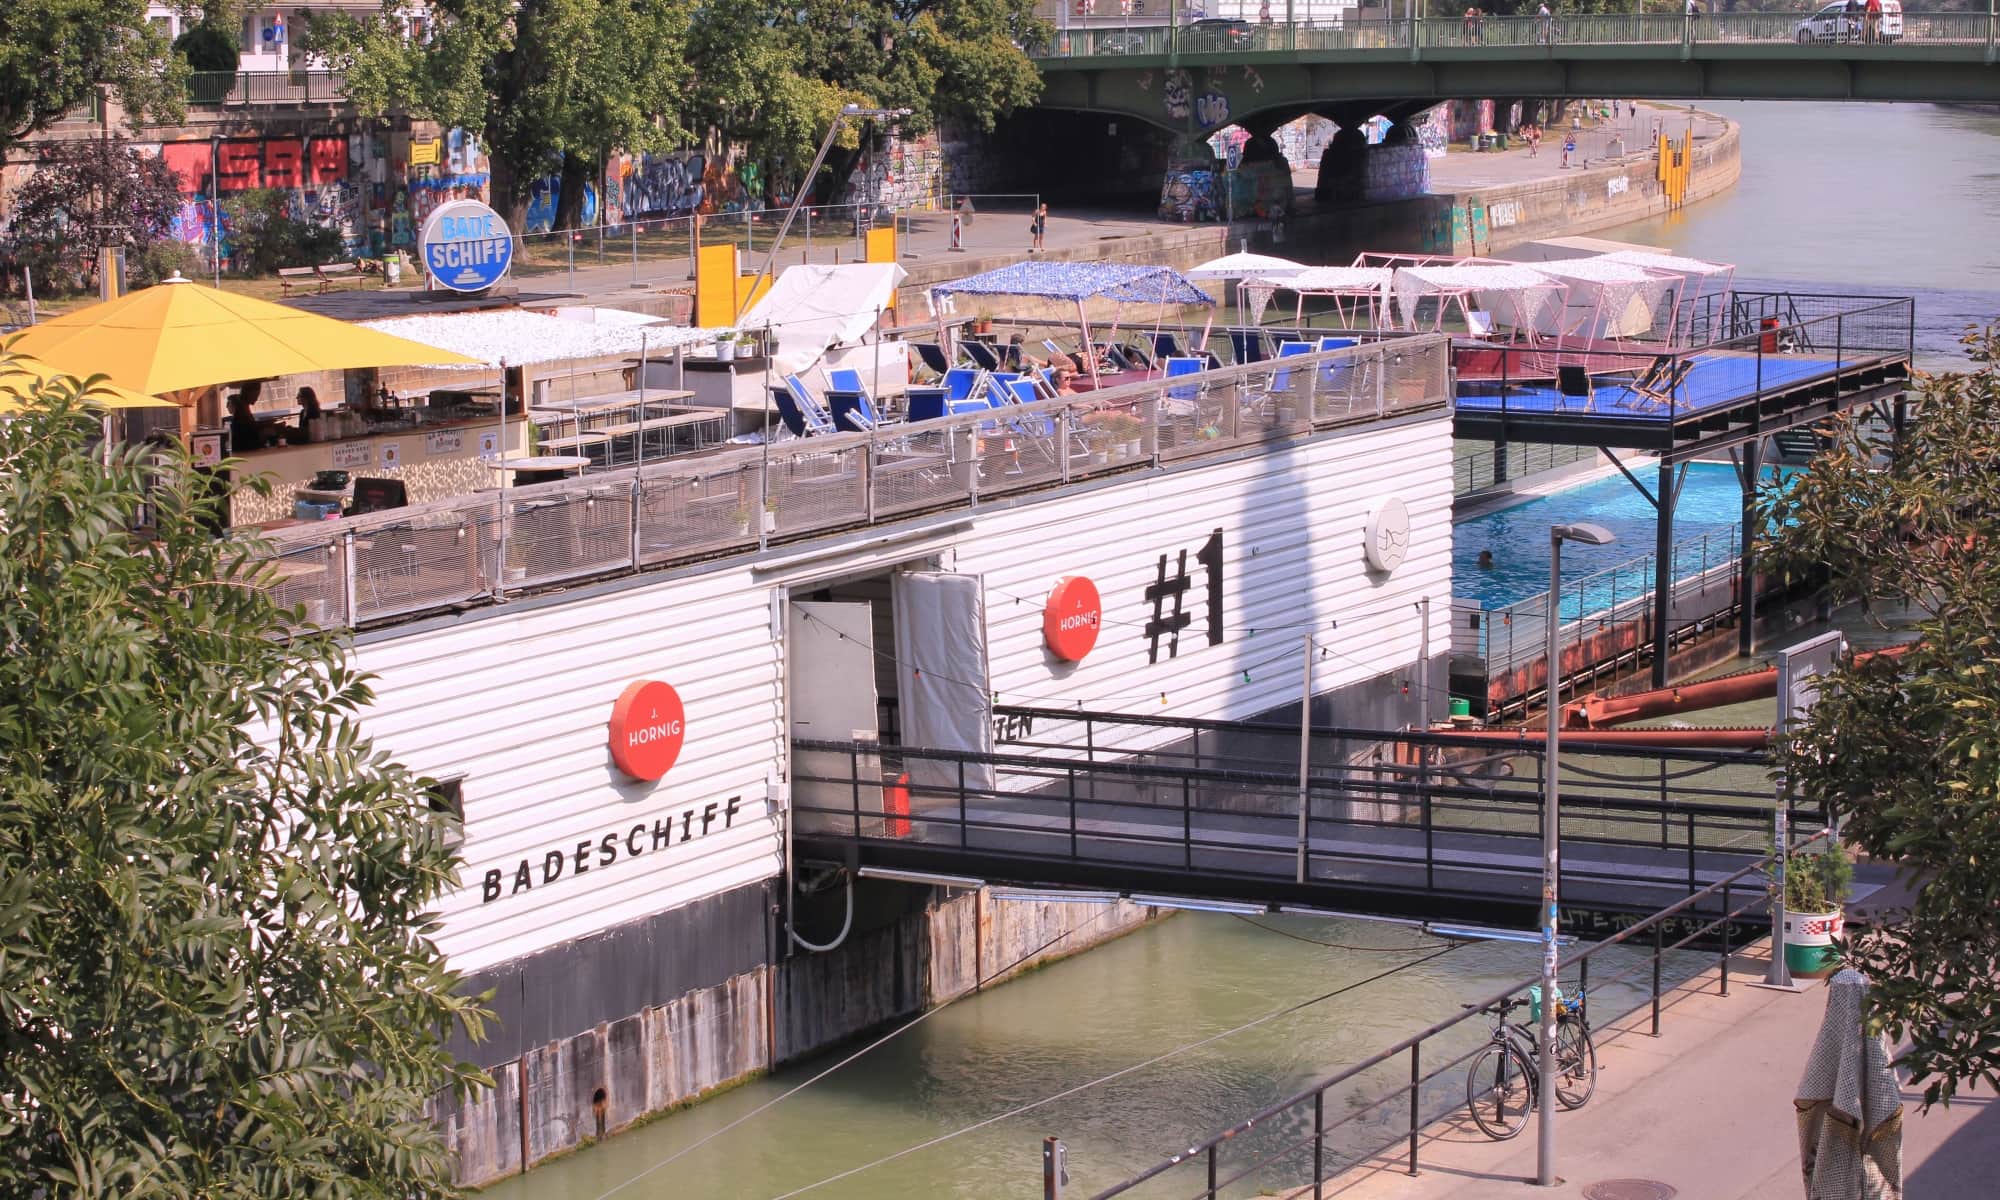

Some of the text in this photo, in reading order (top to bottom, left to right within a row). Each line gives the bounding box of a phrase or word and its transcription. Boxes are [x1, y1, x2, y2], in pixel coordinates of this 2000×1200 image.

[432, 239, 507, 269] SCHIFF
[1145, 526, 1224, 665] #1
[1060, 609, 1098, 632] HORNIG
[650, 708, 659, 720] J.
[992, 711, 1033, 741] TEN
[628, 719, 682, 747] HORNIG
[482, 795, 742, 904] BADESCHIFF
